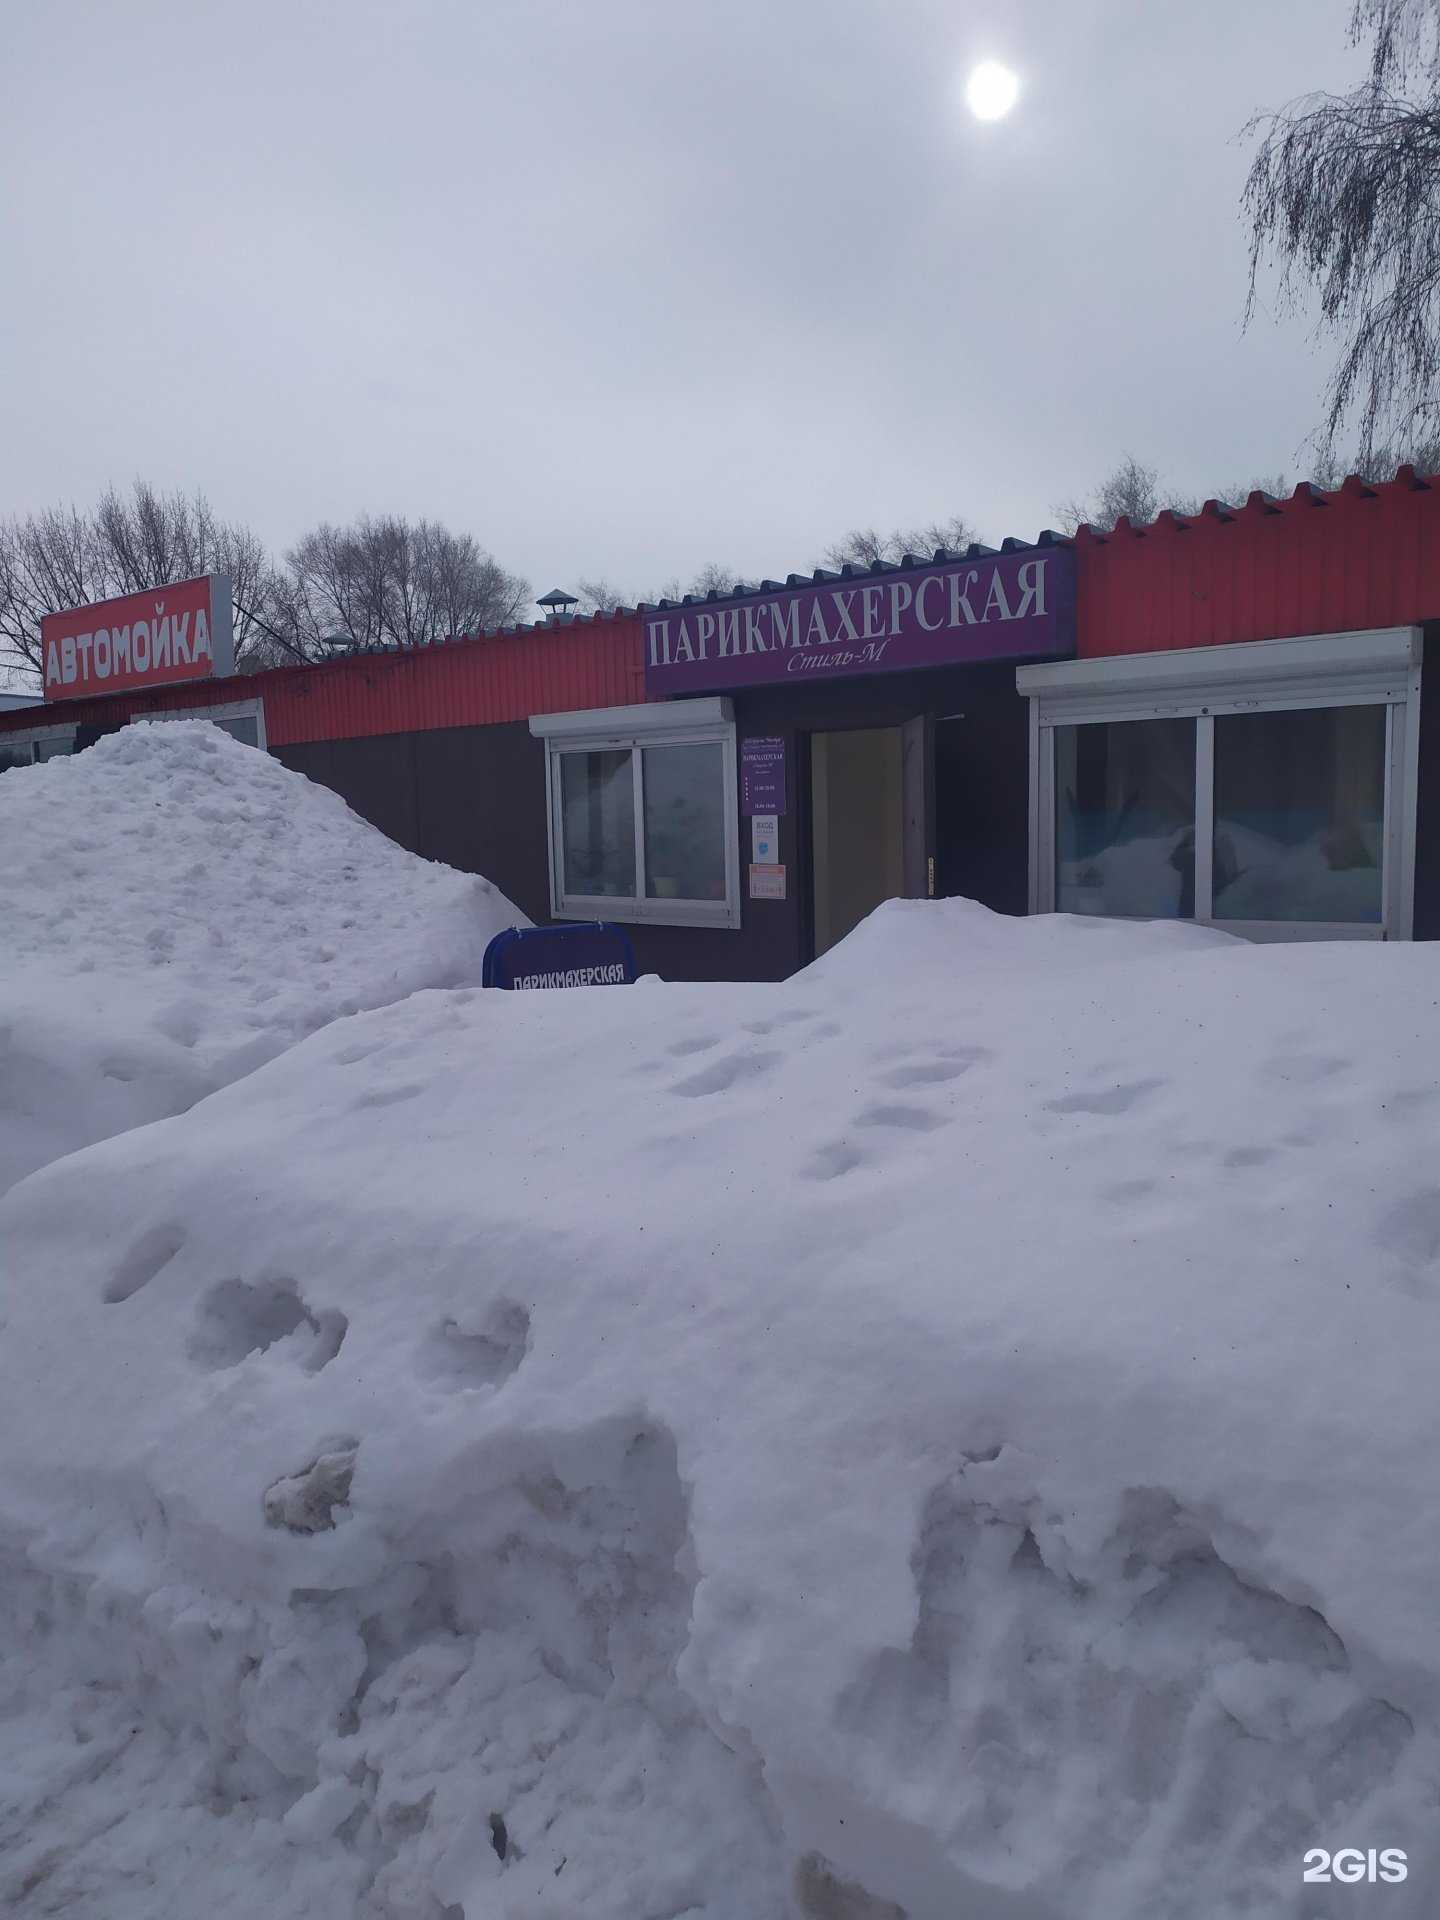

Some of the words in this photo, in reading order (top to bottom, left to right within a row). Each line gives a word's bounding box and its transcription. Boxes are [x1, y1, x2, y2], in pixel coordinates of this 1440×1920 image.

[647, 558, 1050, 666] ПАРИКМАХЕРСКАЯ
[46, 601, 214, 688] АВТОМОЙКА
[786, 638, 889, 673] Стиль-М
[513, 963, 625, 991] ПАРИКМАХЕРСКАЯ
